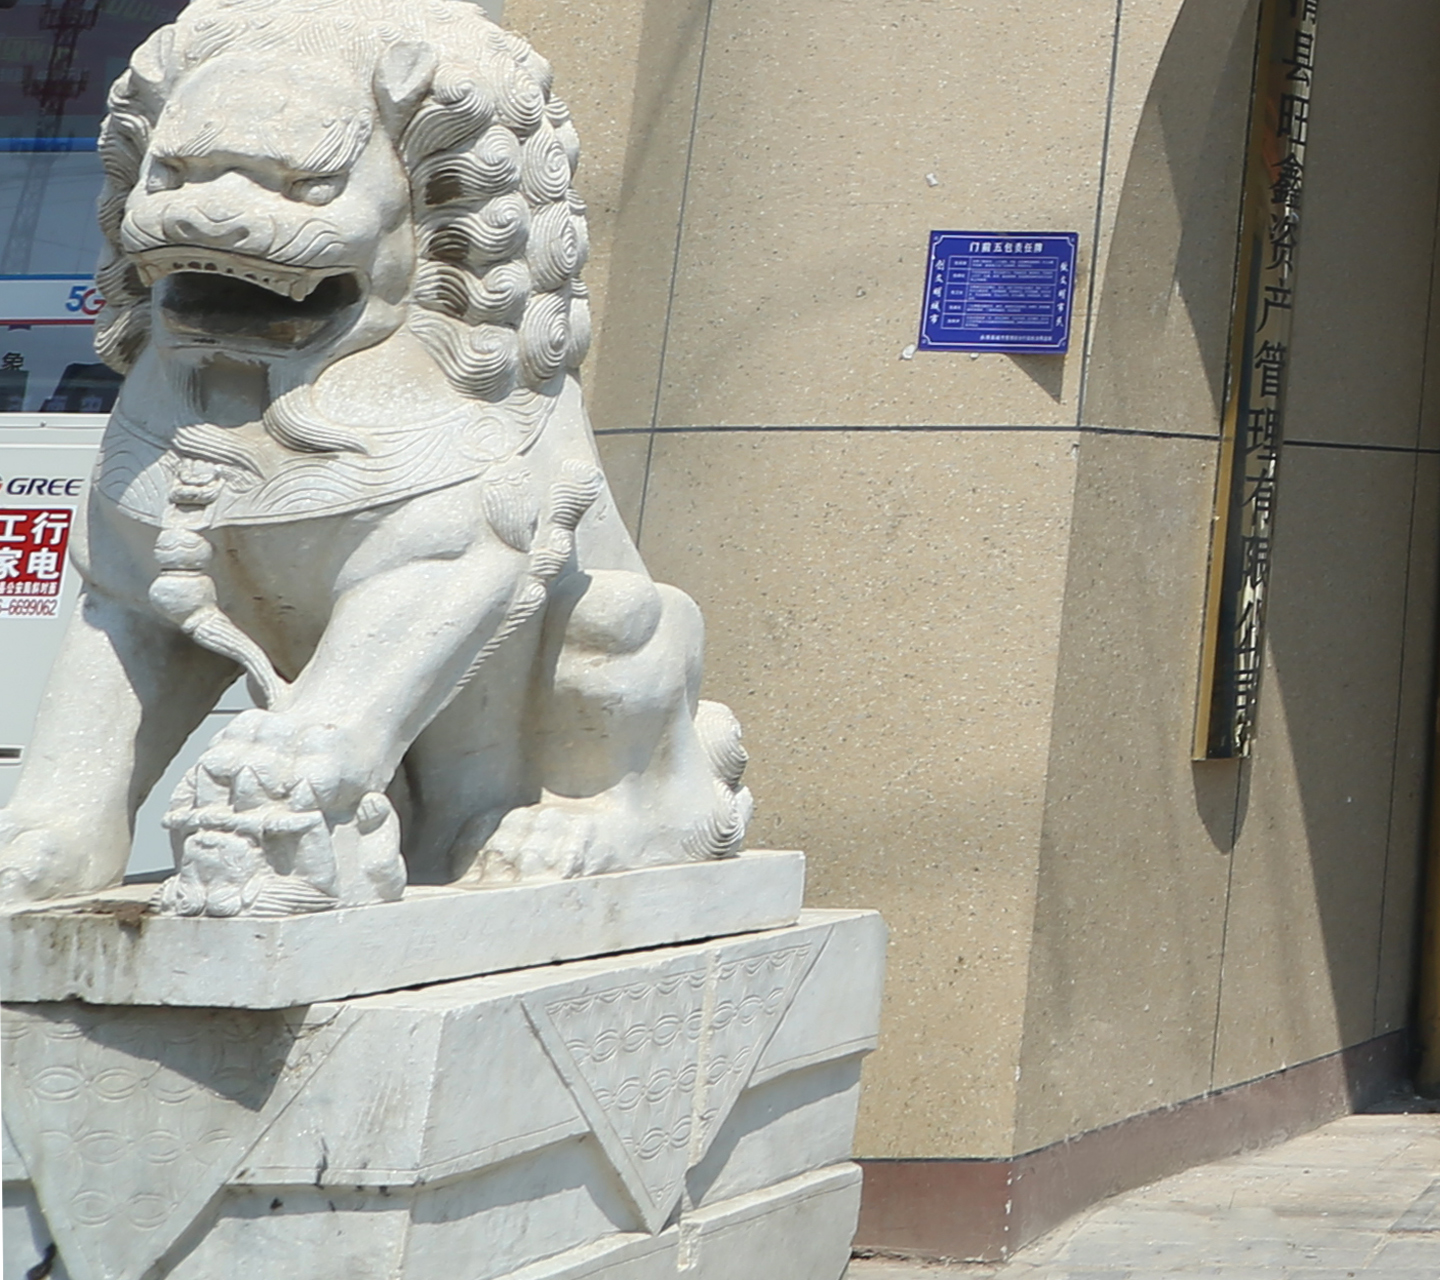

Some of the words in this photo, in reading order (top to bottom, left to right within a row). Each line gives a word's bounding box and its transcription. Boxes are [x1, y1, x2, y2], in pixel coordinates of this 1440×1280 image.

[65, 285, 107, 316] 5G
[6, 477, 85, 496] GREE
[0, 512, 69, 545] 工行
[0, 546, 60, 580] 家电
